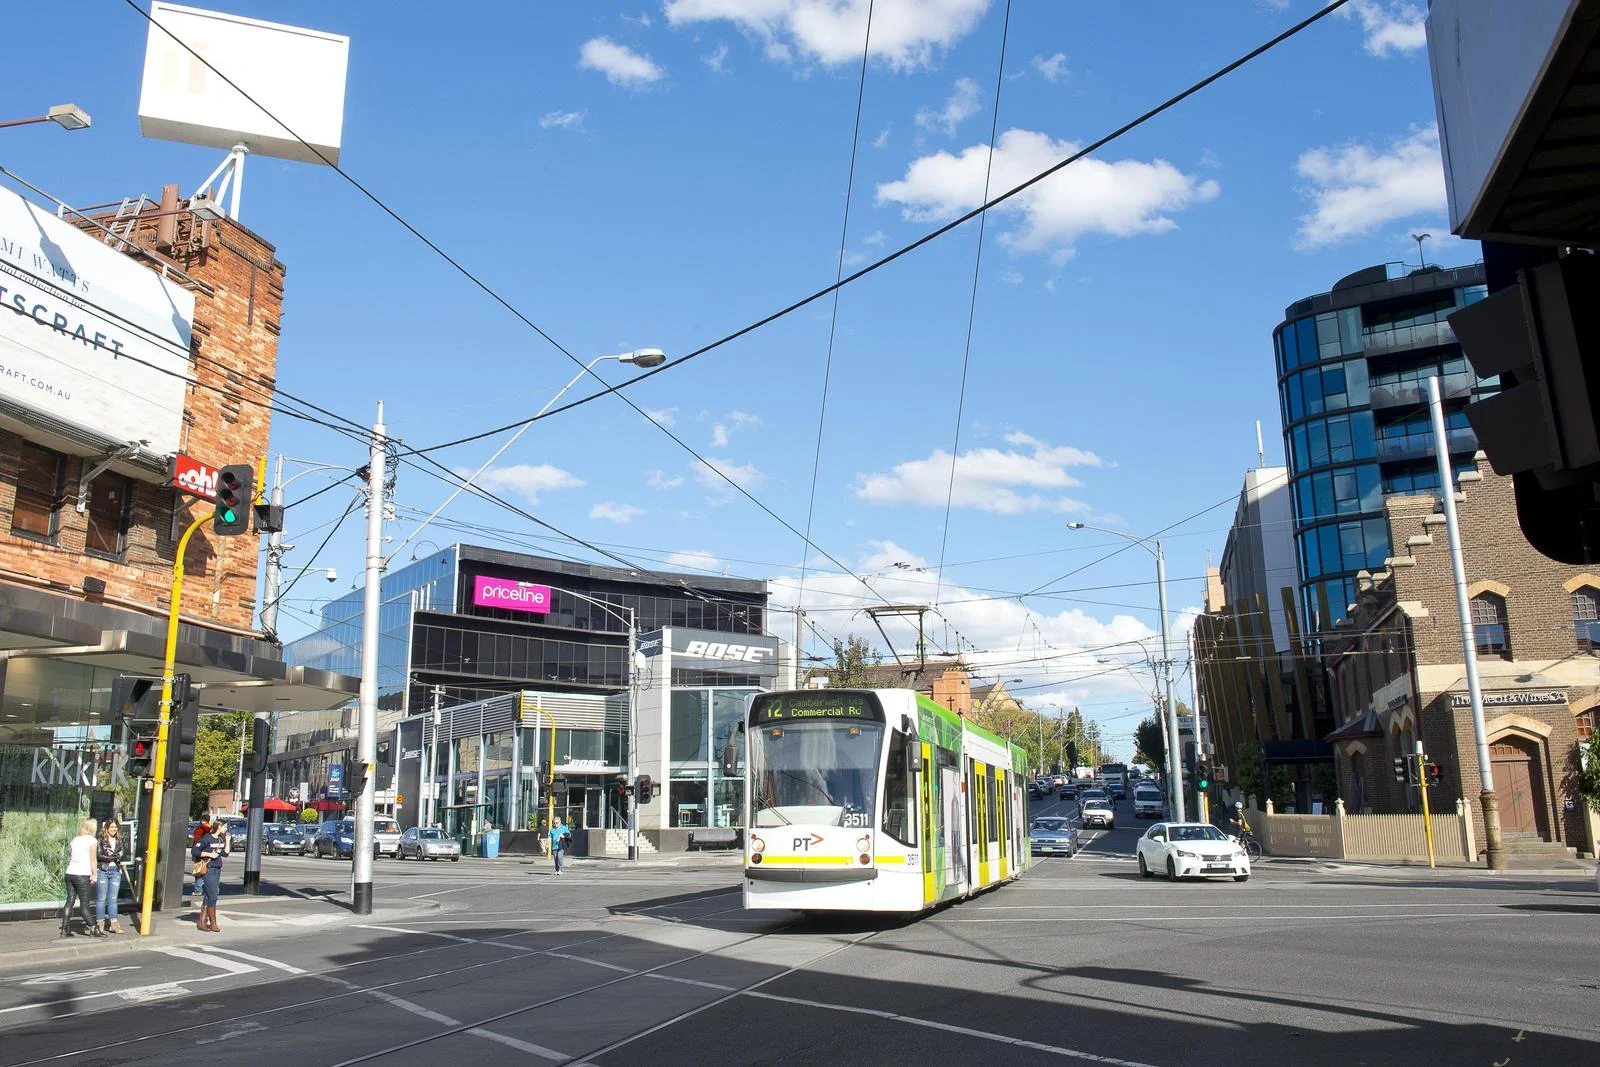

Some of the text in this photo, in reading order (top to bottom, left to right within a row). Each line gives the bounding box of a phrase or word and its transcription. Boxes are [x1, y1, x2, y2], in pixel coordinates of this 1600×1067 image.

[32, 252, 90, 294] WATTS
[482, 584, 545, 604] priceline
[682, 640, 774, 663] BOSE
[790, 706, 862, 718] Commercial Rd
[567, 759, 609, 769] BOSE
[844, 813, 869, 827] 3511
